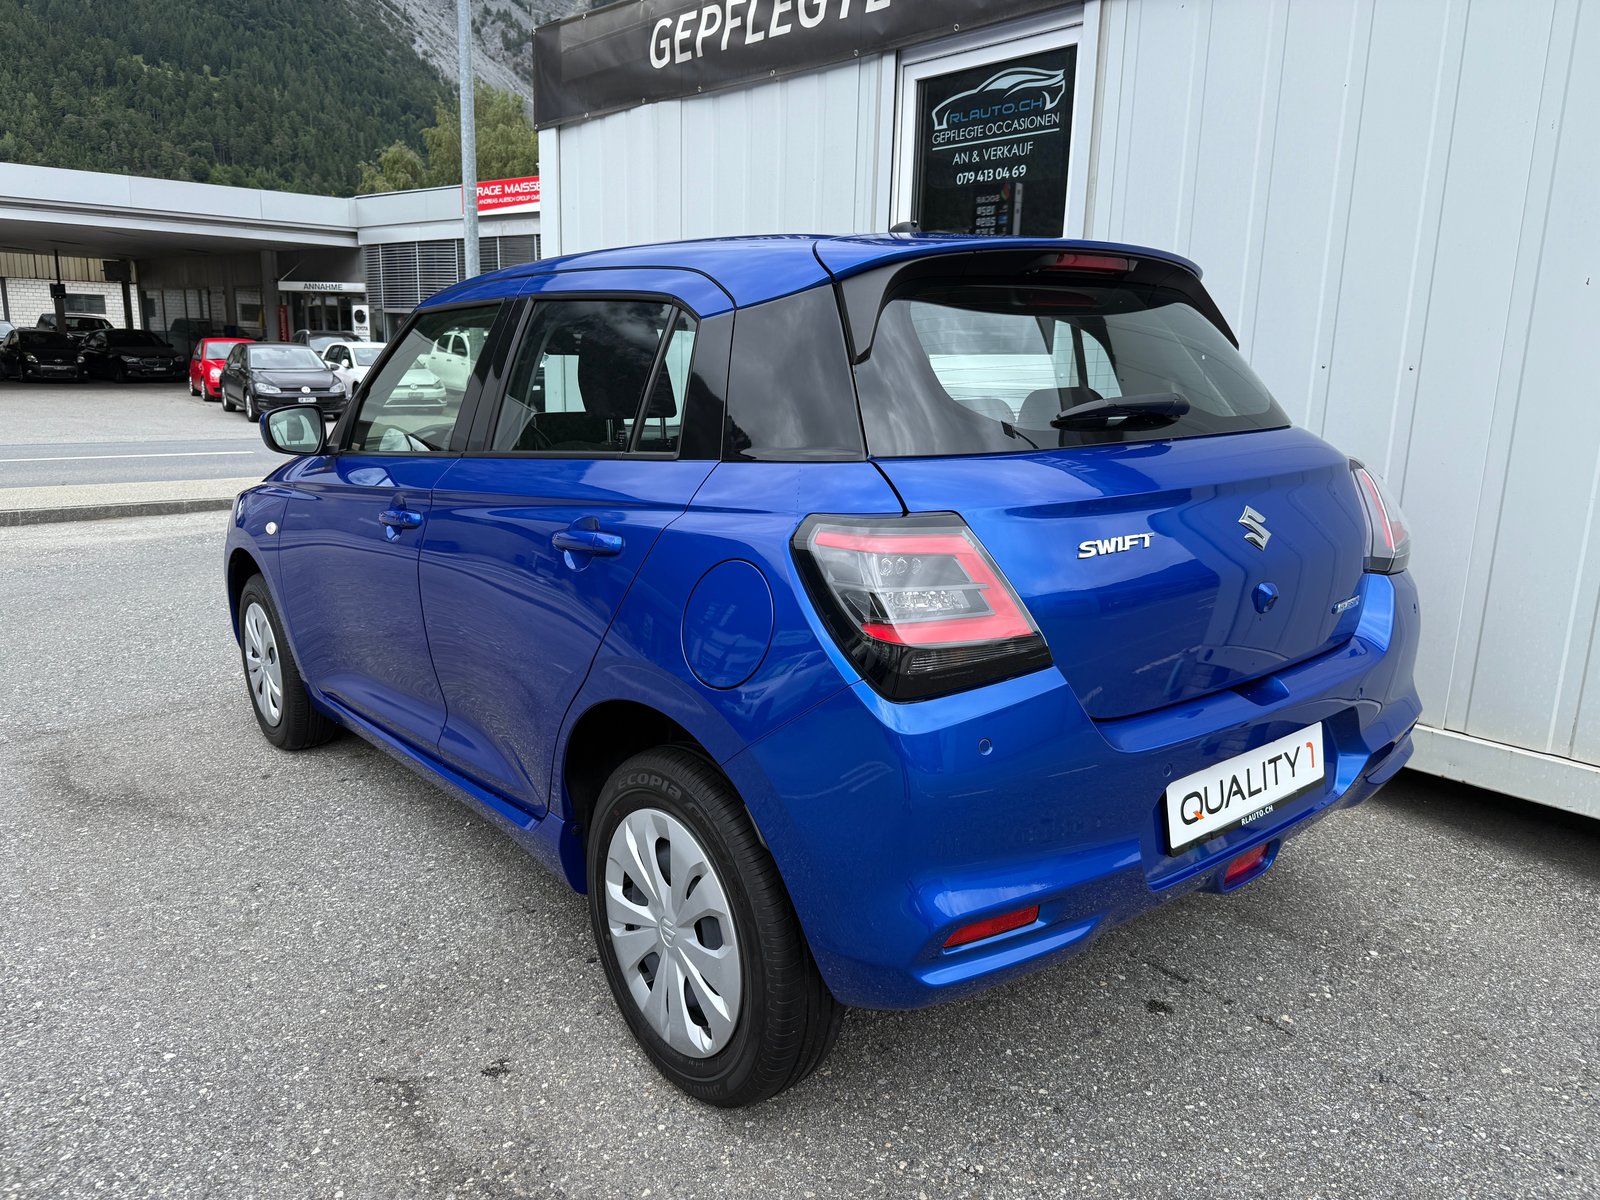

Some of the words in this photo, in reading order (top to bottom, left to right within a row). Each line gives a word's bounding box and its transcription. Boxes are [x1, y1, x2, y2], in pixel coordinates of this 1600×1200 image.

[949, 97, 1043, 123] RLAUTO.CH
[932, 125, 984, 144] GEPFLEGTE
[986, 112, 1060, 135] OCCASIONEN
[952, 151, 969, 165] AN
[971, 150, 980, 163] &
[983, 141, 1034, 160] VERKAUF
[956, 171, 975, 185] 079
[977, 169, 994, 182] 413
[995, 167, 1010, 180] 04
[1012, 164, 1027, 178] 69
[476, 185, 503, 197] RAGE
[504, 181, 540, 194] MAISSE
[303, 283, 343, 291] ANNAHME
[1077, 532, 1155, 559] SWIFT
[1180, 746, 1300, 826] QUALITY
[1305, 741, 1315, 769] 1
[1241, 804, 1274, 826] RLAUTO.CH
